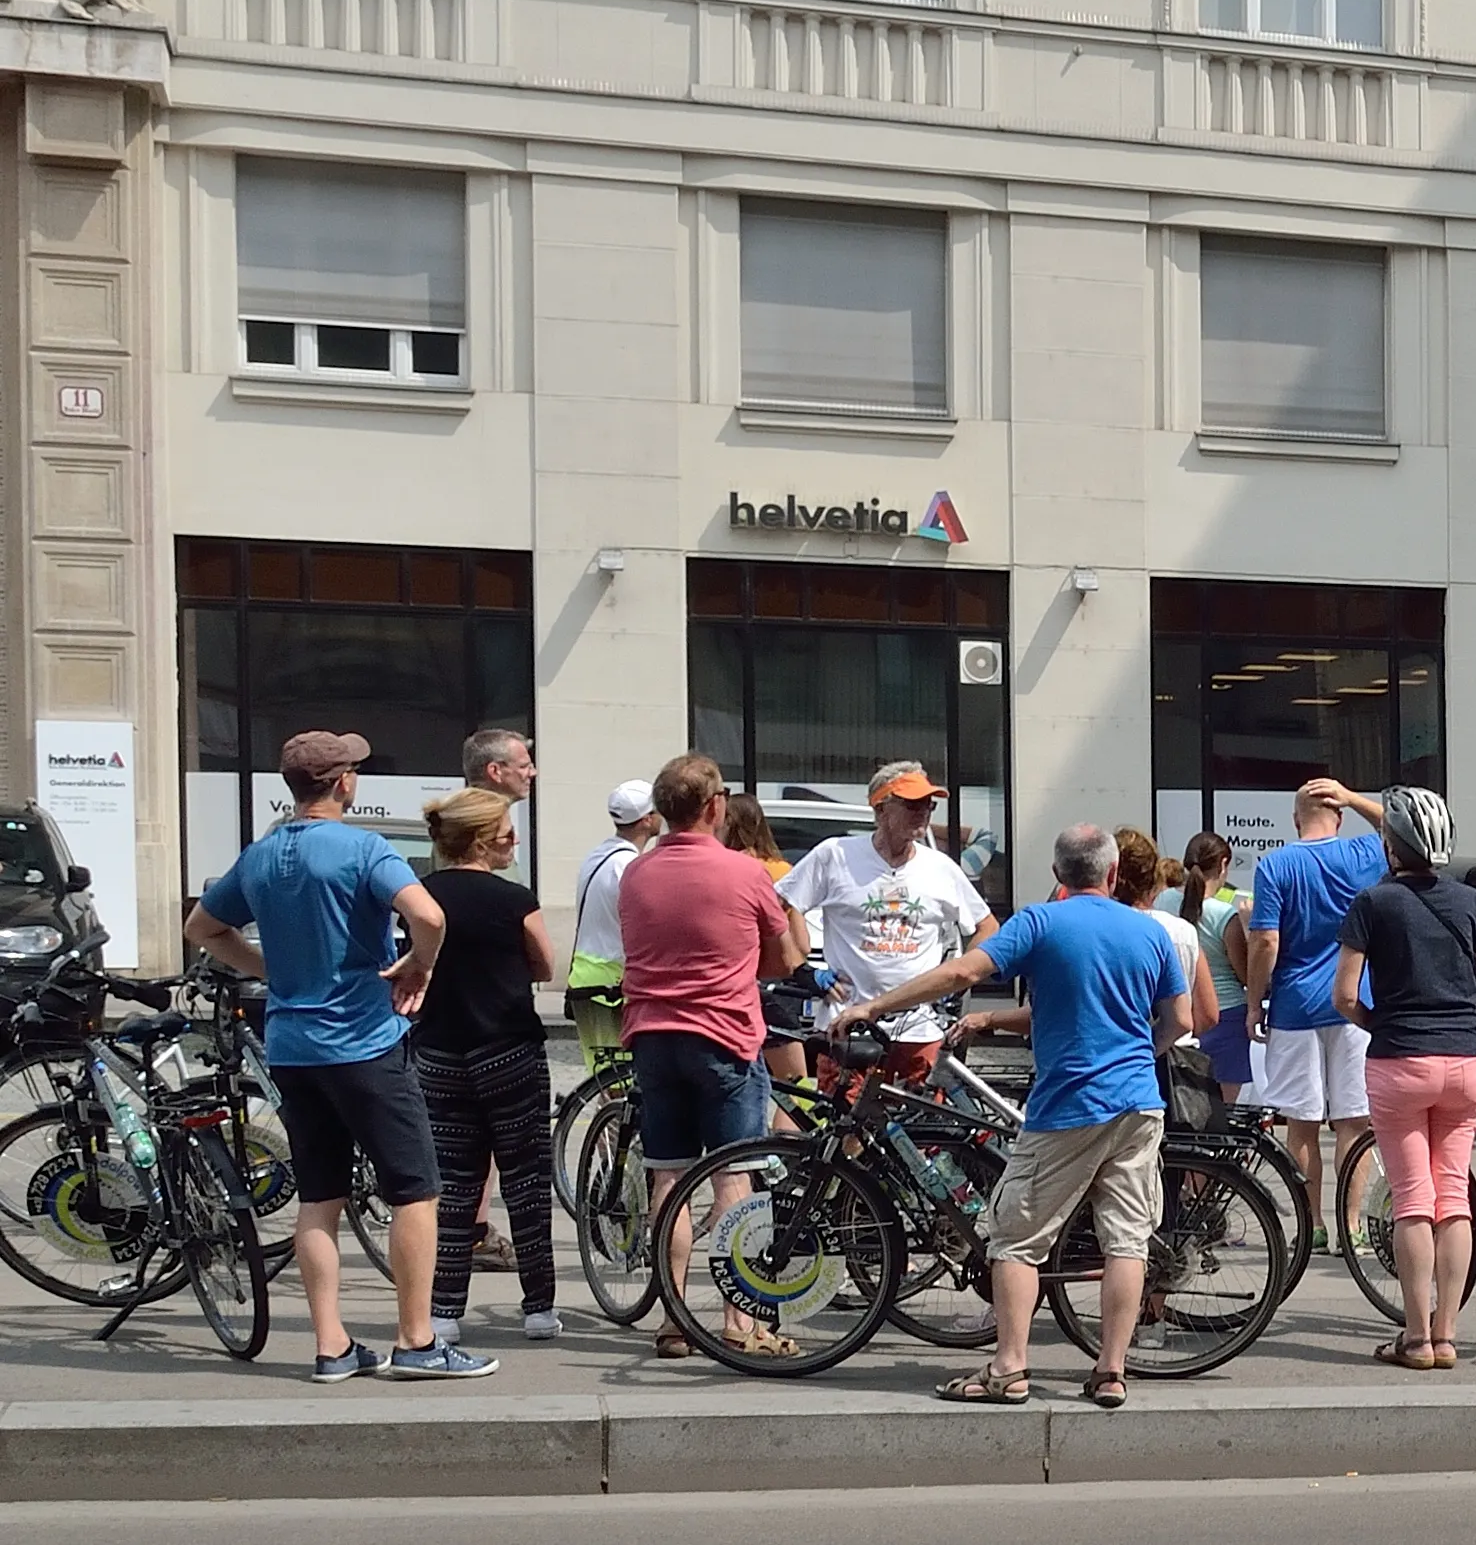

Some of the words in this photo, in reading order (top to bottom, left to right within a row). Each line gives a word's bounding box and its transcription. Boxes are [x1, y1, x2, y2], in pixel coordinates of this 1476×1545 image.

[74, 389, 89, 407] 11
[729, 491, 908, 534] helvetia
[48, 753, 106, 766] helvetia
[49, 779, 126, 787] Generaldirektion
[1226, 815, 1275, 827] Heute.
[716, 1197, 773, 1254] pedalpower
[713, 1260, 728, 1276] 34
[719, 1276, 737, 1295] 72
[732, 1291, 758, 1314] 729
